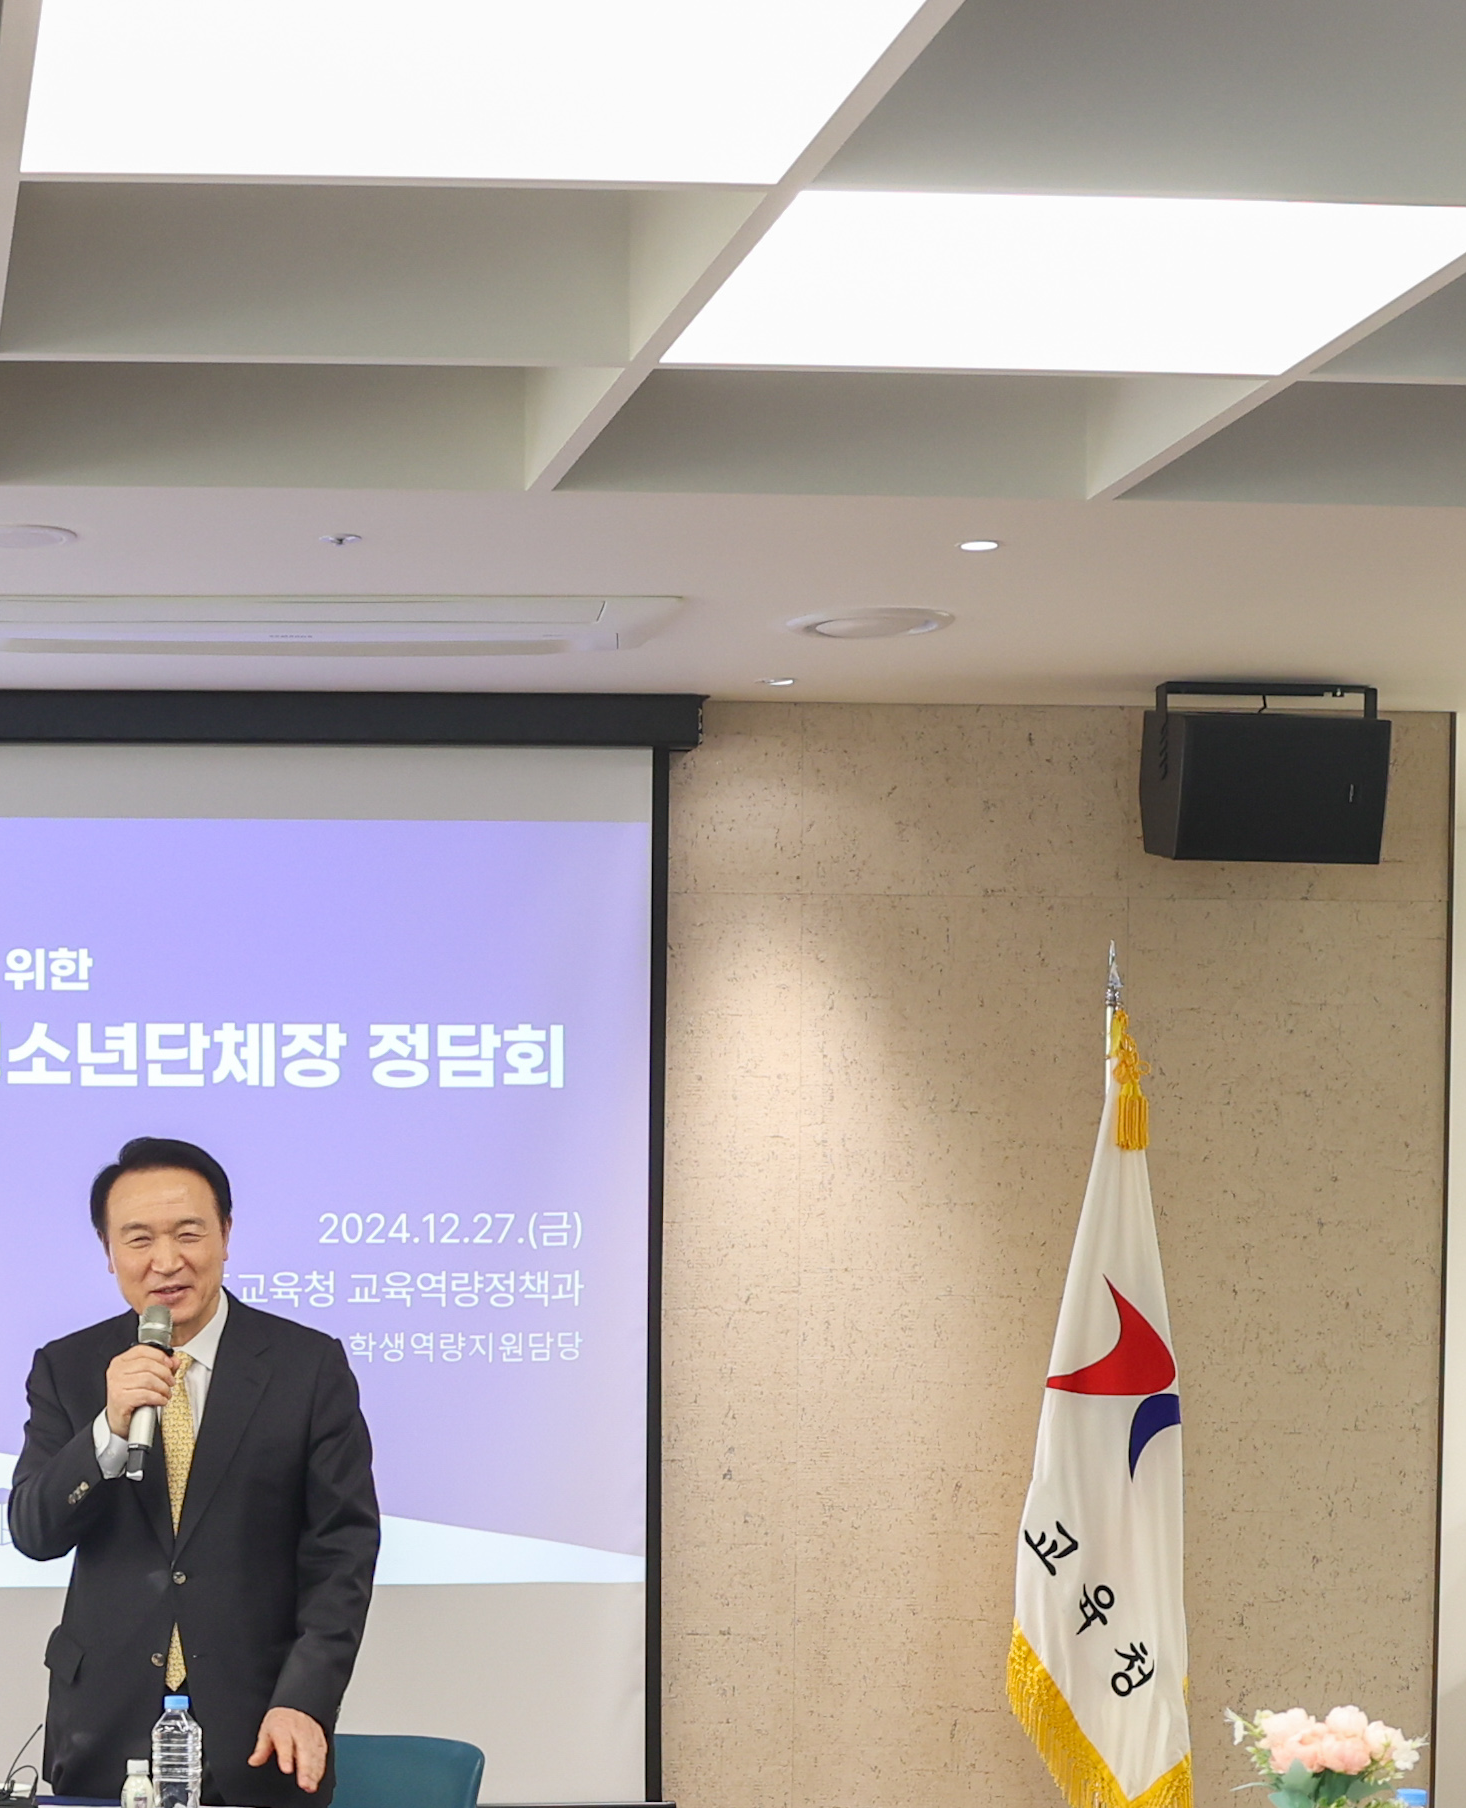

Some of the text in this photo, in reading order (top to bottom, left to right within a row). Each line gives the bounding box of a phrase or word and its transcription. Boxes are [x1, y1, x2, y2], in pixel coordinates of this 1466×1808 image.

[4, 946, 93, 991] 위한
[369, 1023, 564, 1089] 정담회
[318, 1211, 583, 1249] 2024.12.27.(금)
[347, 1270, 584, 1308] 교육역량정책과
[348, 1331, 583, 1363] 학생역량지원담당
[1024, 1520, 1155, 1698] 교육청
